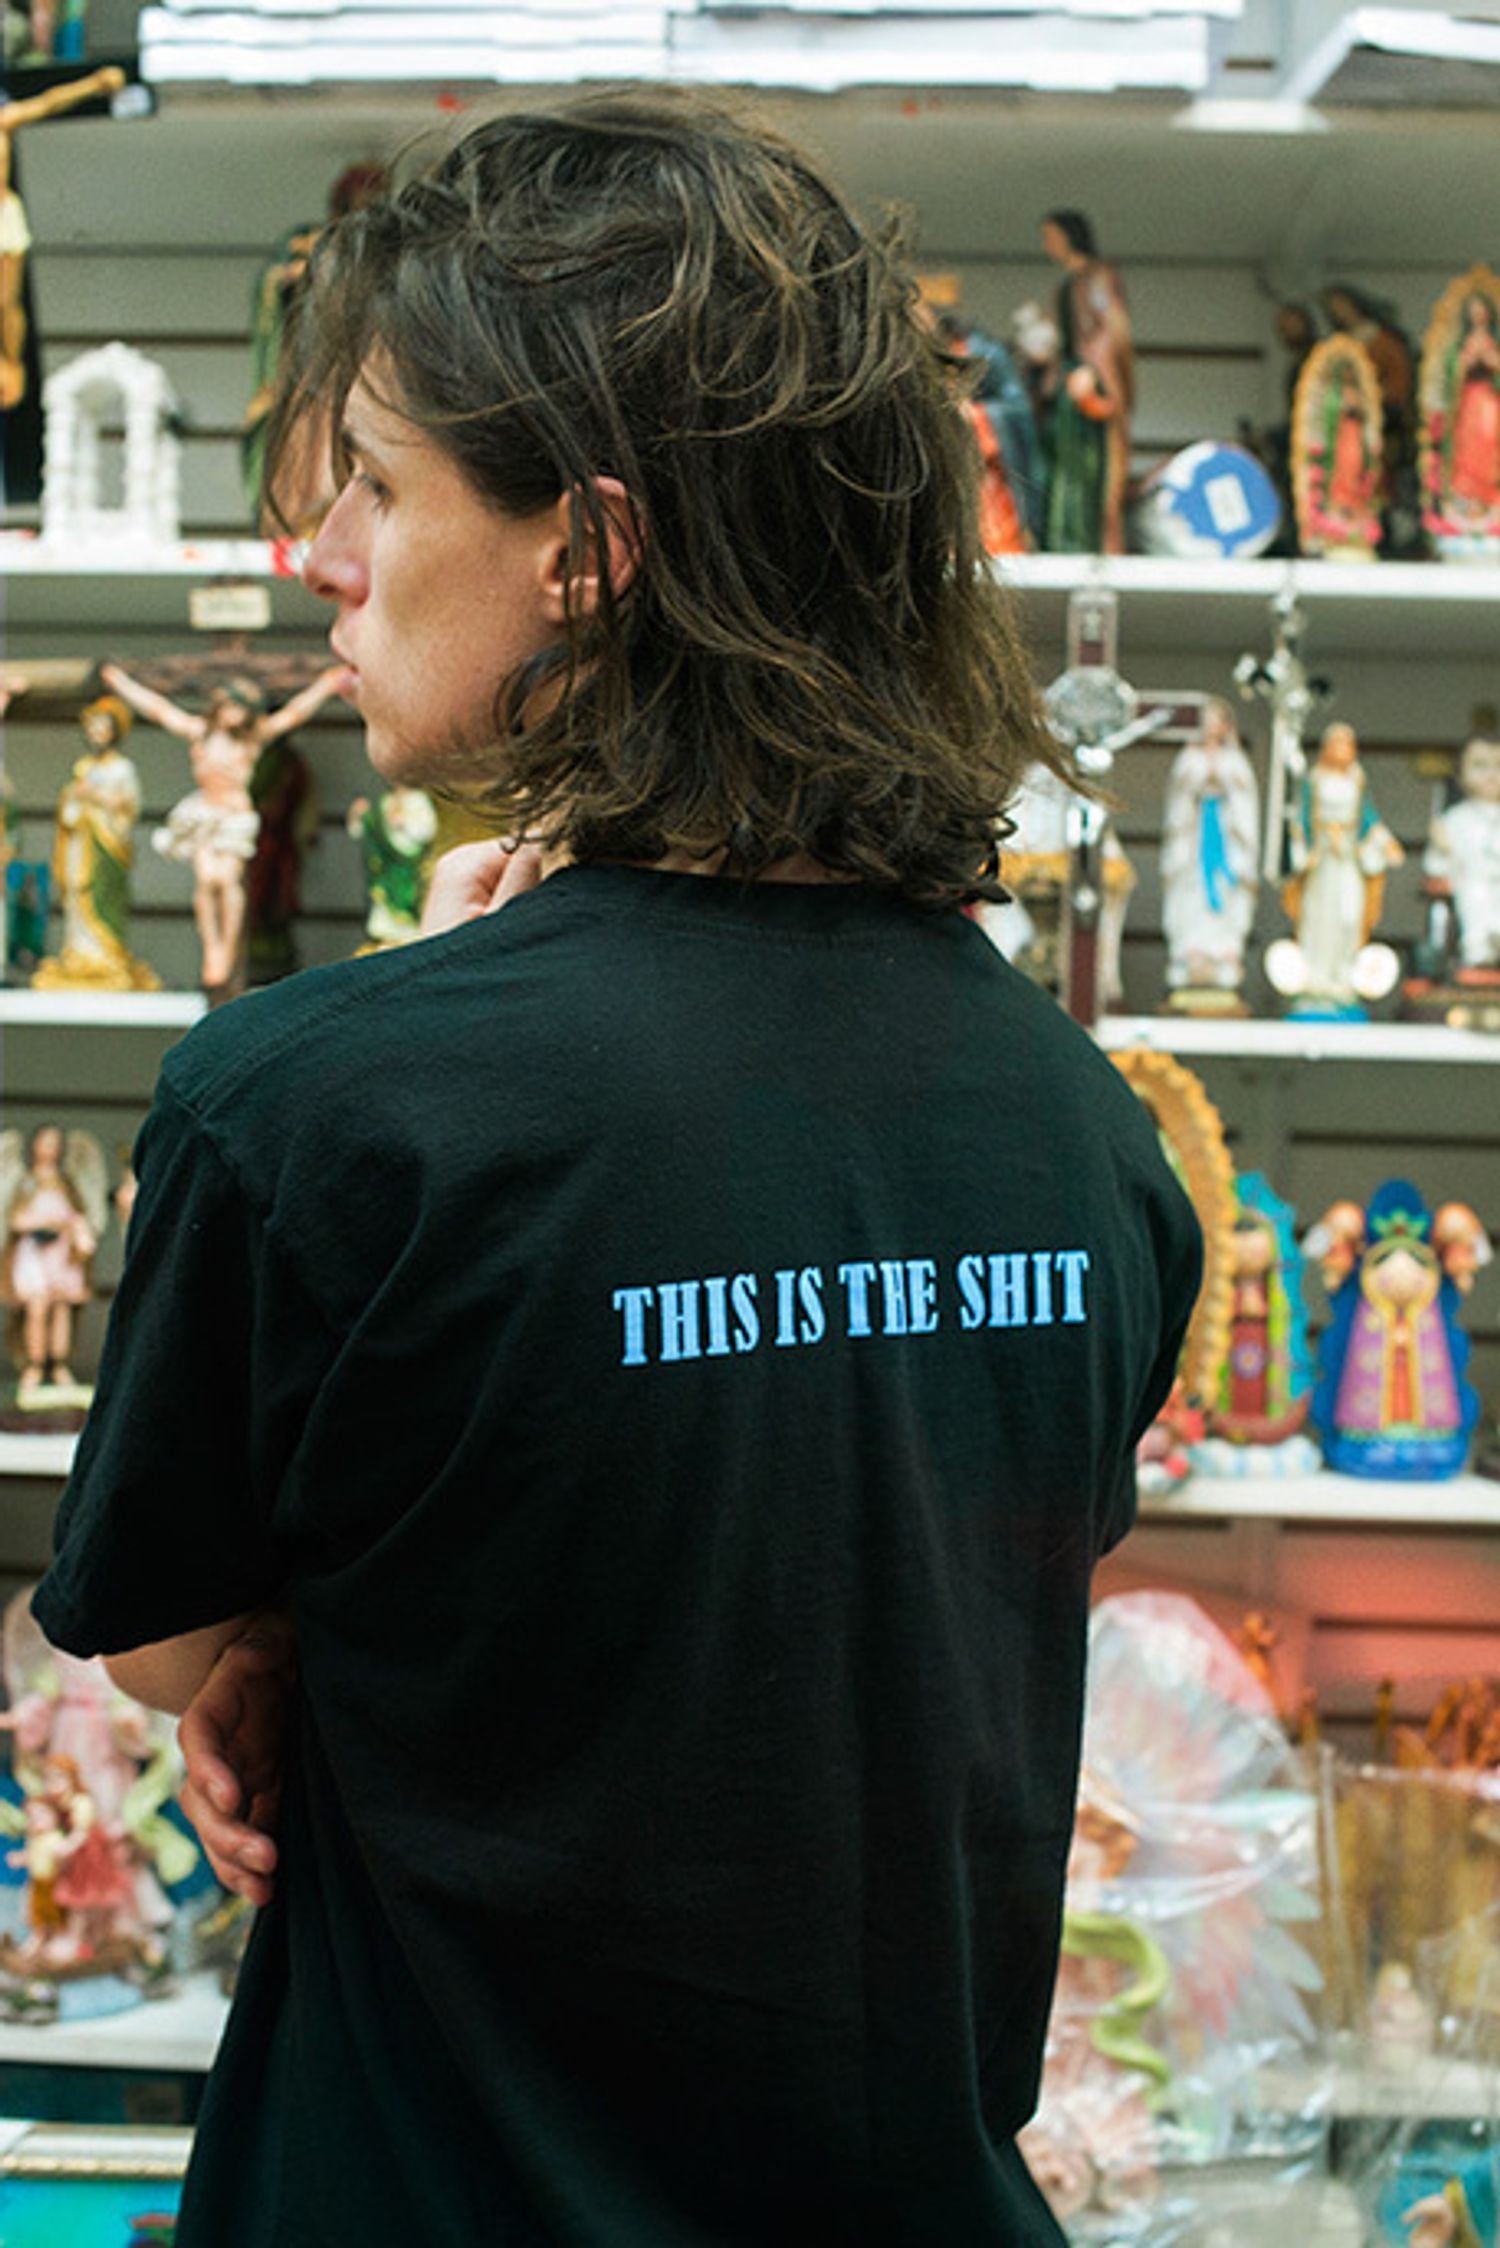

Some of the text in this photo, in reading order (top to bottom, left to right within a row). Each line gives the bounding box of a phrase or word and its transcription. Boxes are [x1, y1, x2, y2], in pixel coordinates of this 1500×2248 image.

[612, 1249, 1091, 1366] THIS IS THE SHIT
